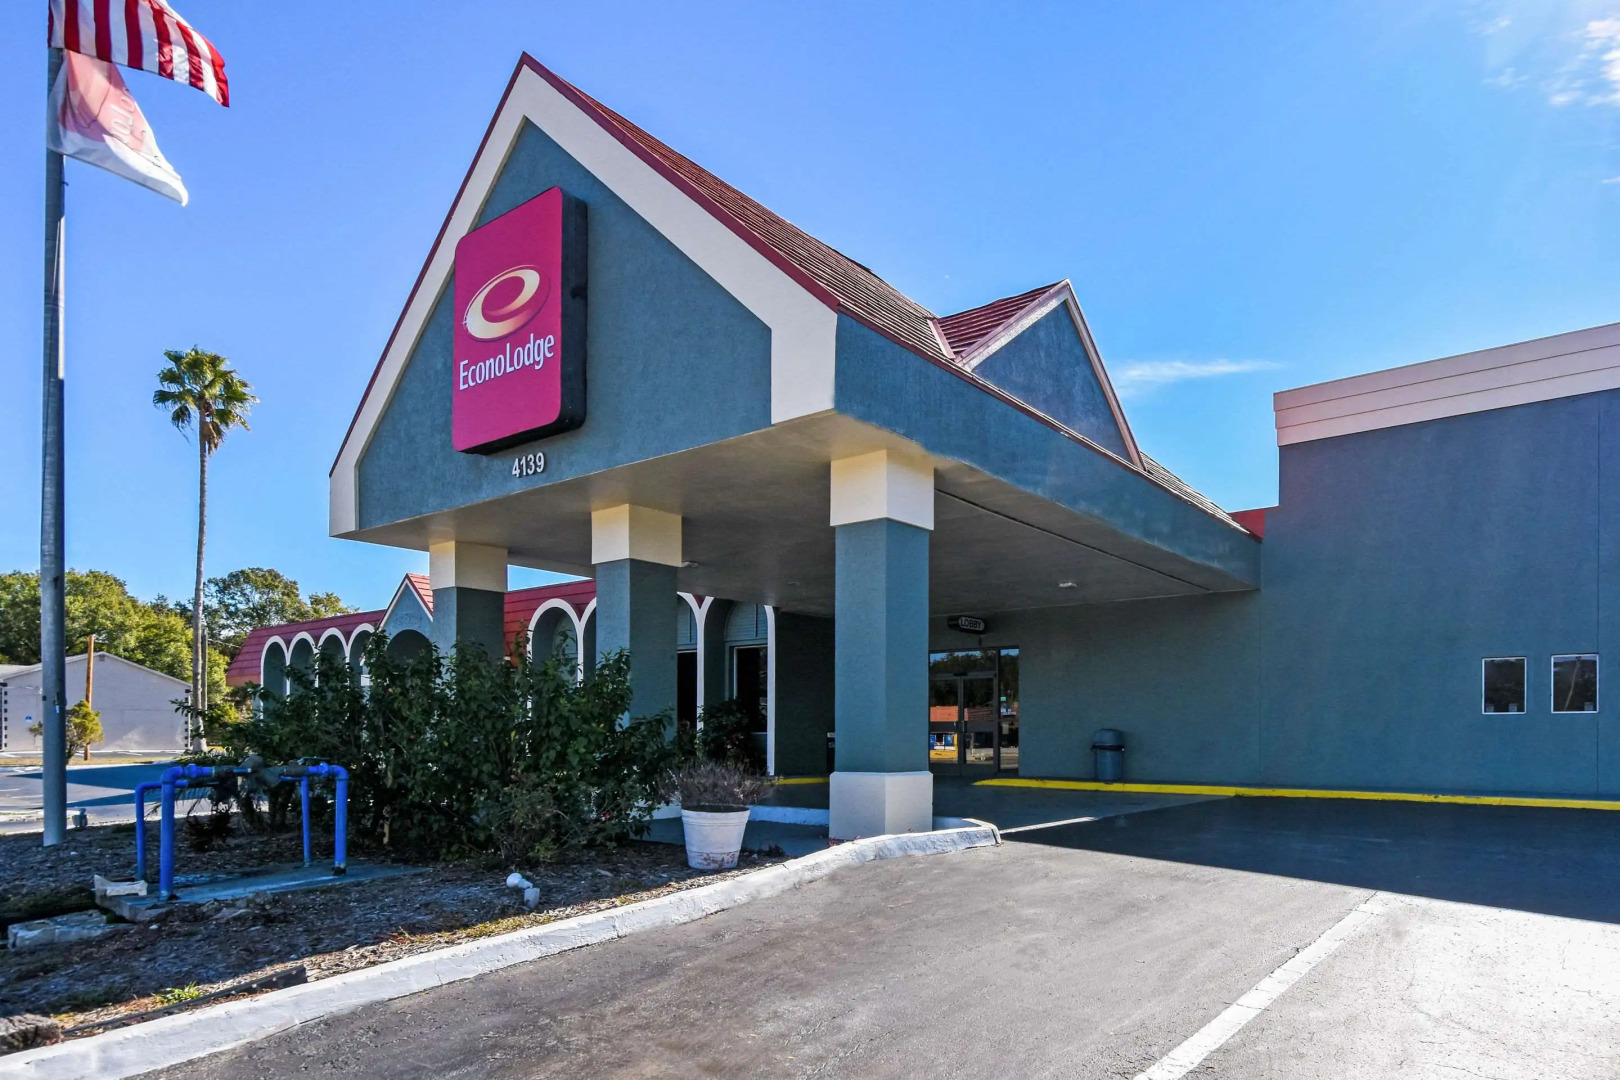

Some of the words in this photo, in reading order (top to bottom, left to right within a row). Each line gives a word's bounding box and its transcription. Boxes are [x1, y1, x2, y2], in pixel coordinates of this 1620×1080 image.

[459, 333, 555, 391] EconoLodge
[511, 452, 545, 478] 4139
[960, 618, 982, 629] LOBBY
